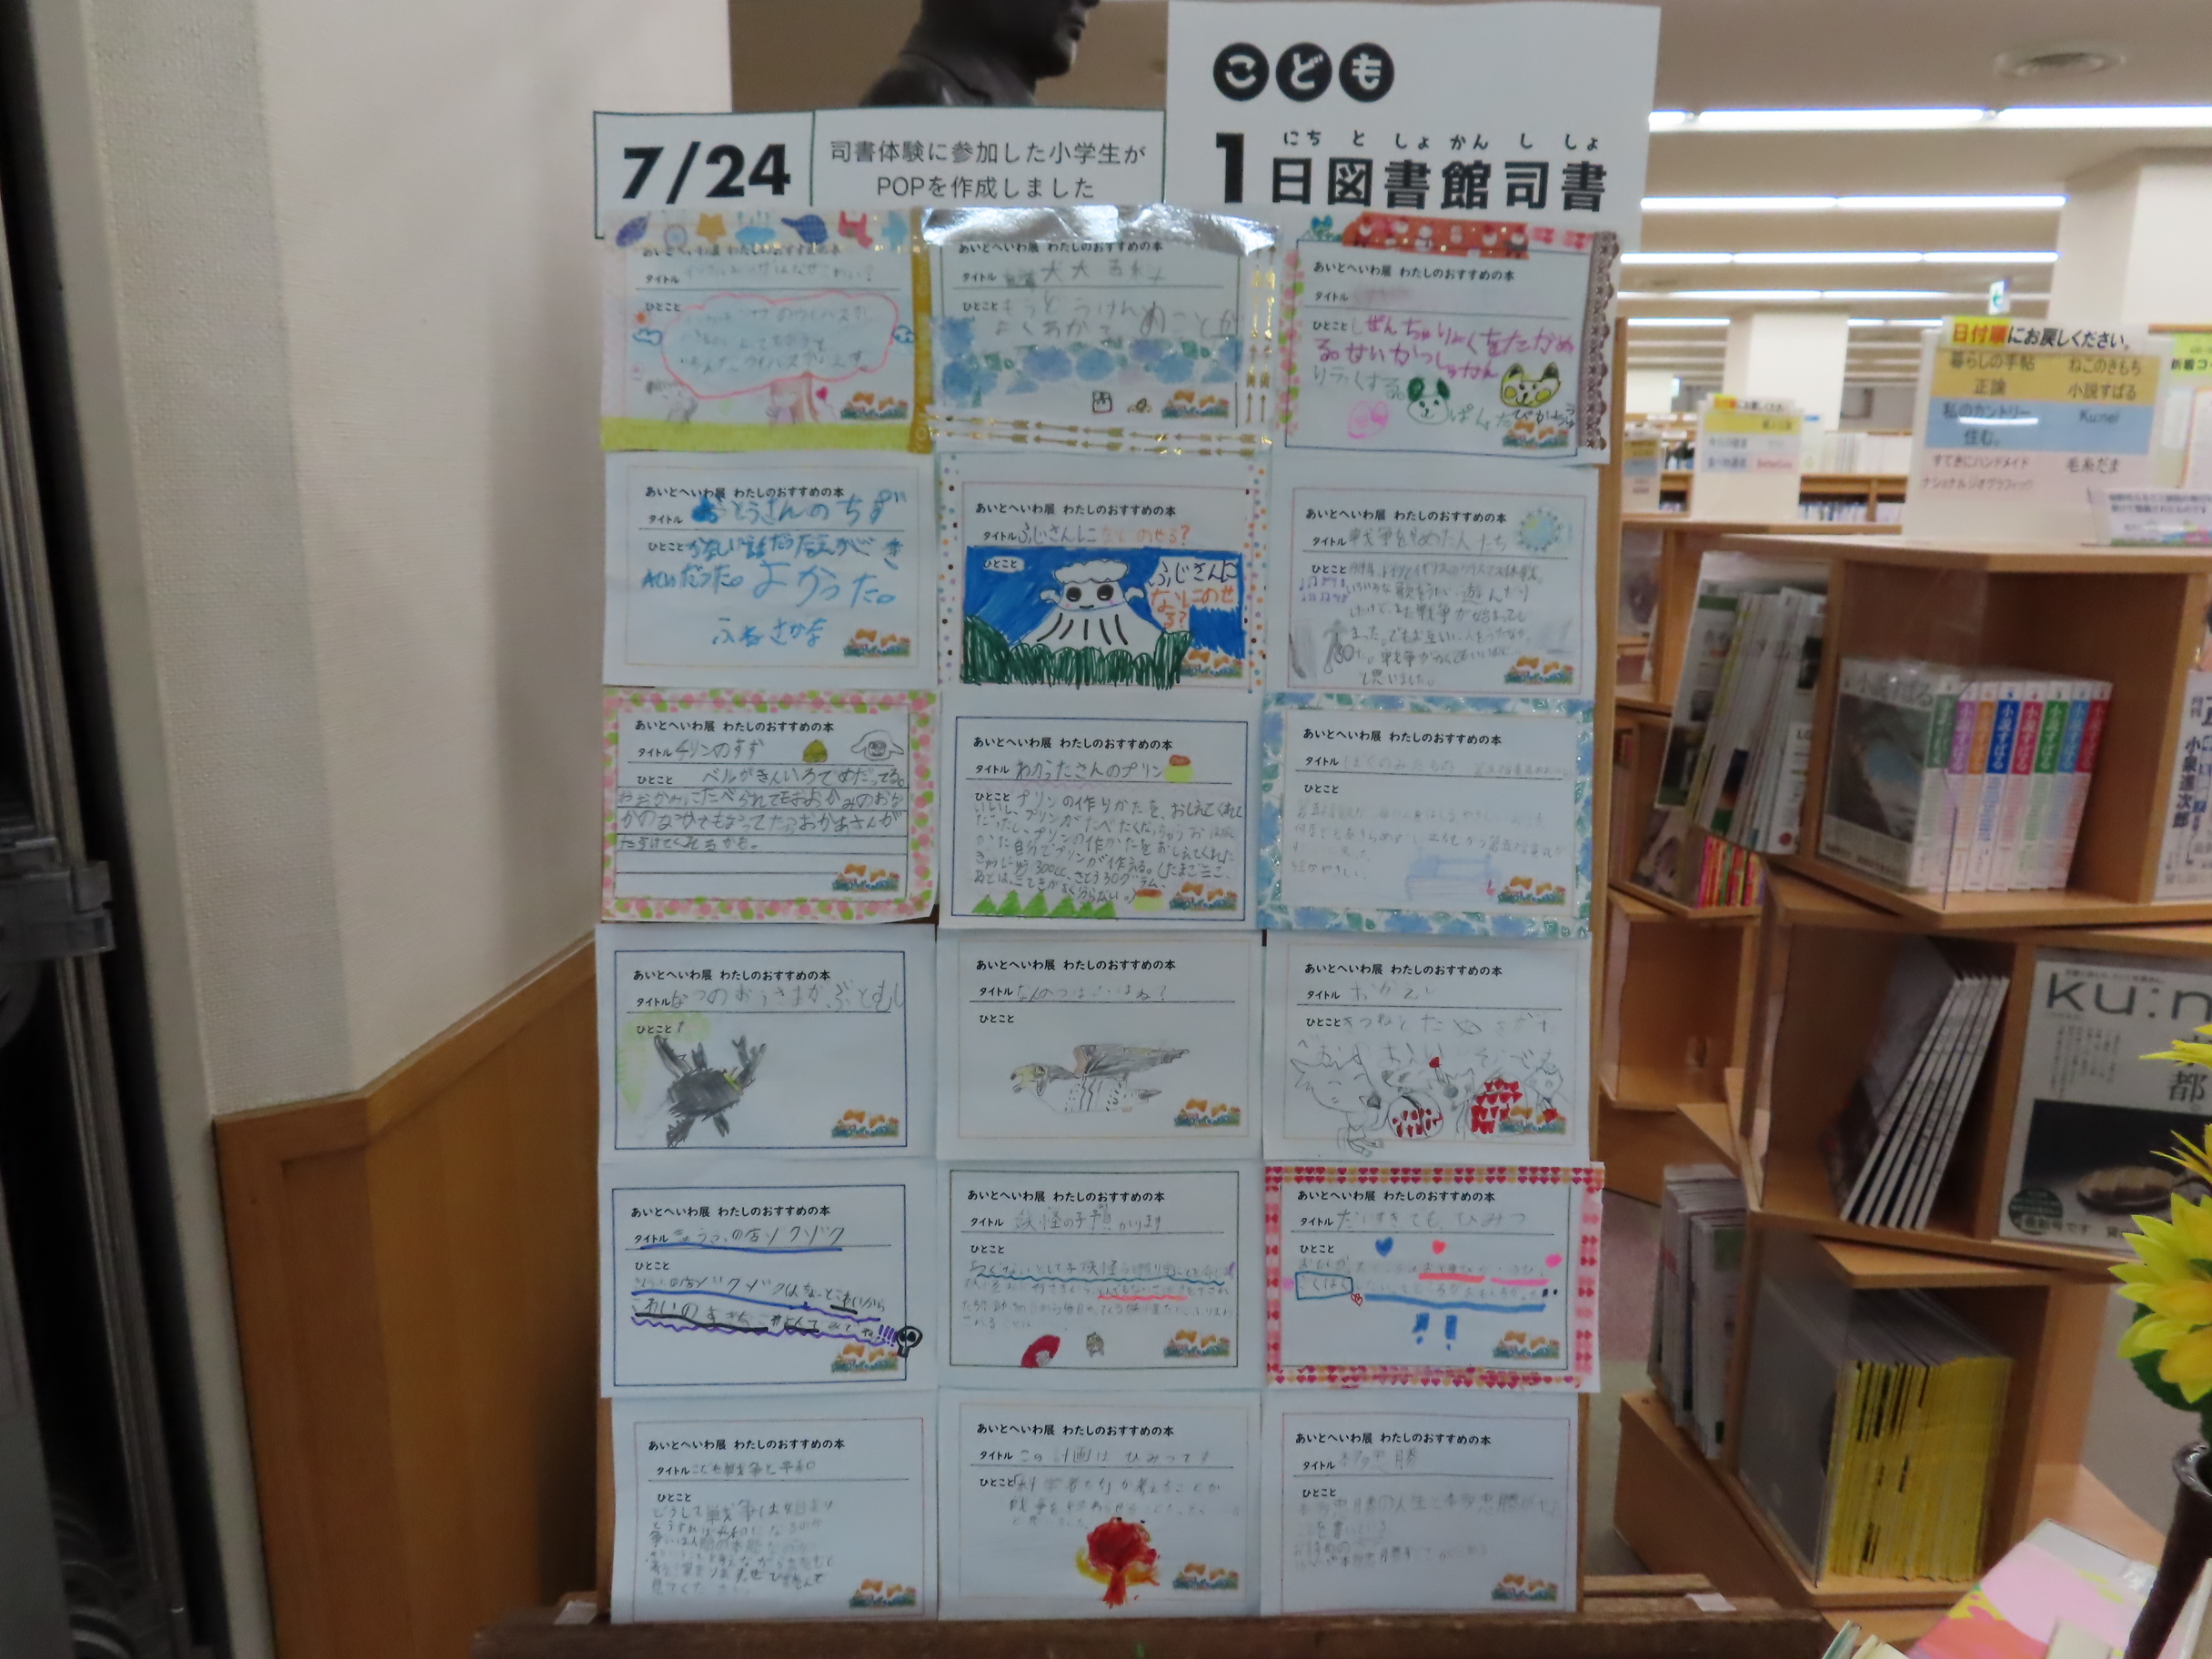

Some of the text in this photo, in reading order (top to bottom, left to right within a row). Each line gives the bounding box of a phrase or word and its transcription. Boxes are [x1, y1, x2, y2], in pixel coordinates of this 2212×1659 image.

[1219, 46, 1390, 97] こども
[1283, 130, 1599, 152] にち と しょ かん し しょ
[830, 139, 1147, 166] 司書体験に参加した小学生が
[622, 141, 790, 204] 7/24
[1216, 133, 1607, 212] 1日図書館司書
[877, 176, 1095, 200] POPを作成しました
[959, 241, 1162, 254] あいとへいわ展 わたしのおすすめの本
[962, 272, 996, 282] タイトル
[1313, 261, 1514, 282] あいとへいわ展 わたしのおすすめの本
[1315, 291, 1348, 302] タイトル
[963, 301, 998, 312] ひとこと
[1313, 320, 1348, 332] ひとこと
[646, 487, 845, 499] あいとへいわ展 わたしのおすすめの本
[976, 502, 1176, 517] あいとへいわ展 わたしのおすすめの本
[649, 515, 683, 525] タイトル
[1306, 508, 1507, 524] あいとへいわ展 わたしのおすすめの本
[983, 530, 1017, 541] タイトル
[649, 541, 683, 552] ひとこと
[1312, 536, 1346, 547] タイトル
[983, 558, 1018, 569] ひとこと
[1312, 564, 1346, 575] ひとこと
[636, 719, 834, 733] あいとへいわ展 わたしのおすすめの本
[1303, 728, 1502, 746] あいとへいわ展 わたしのおすすめの本
[973, 736, 1173, 750] あいとへいわ展 わたしのおすすめの本
[638, 747, 671, 758] タイトル
[1305, 756, 1339, 767] タイトル
[975, 764, 1010, 775] タイトル
[638, 775, 673, 785] ひとこと
[1303, 784, 1339, 794] ひとこと
[975, 791, 1010, 802] ひとこと
[976, 959, 1176, 971] あいとへいわ展 わたしのおすすめの本
[1304, 962, 1503, 977] あいとへいわ展 わたしのおすすめの本
[633, 969, 830, 981] あいとへいわ展 わたしのおすすめの本
[980, 987, 1013, 998] タイトル
[1307, 990, 1340, 1000] タイトル
[637, 997, 670, 1007] タイトル
[980, 1014, 1014, 1023] ひとこと
[1306, 1017, 1342, 1028] ひとこと
[637, 1024, 672, 1034] ひとこと
[968, 1190, 1165, 1203] あいとへいわ展 わたしのおすすめの本
[1297, 1190, 1495, 1203] あいとへいわ展 わたしのおすすめの本
[631, 1205, 830, 1218] あいとへいわ展 わたしのおすすめの本
[970, 1217, 1004, 1227] タイトル
[1300, 1216, 1333, 1227] タイトル
[635, 1233, 669, 1244] タイトル
[970, 1244, 1005, 1254] ひとこと
[1300, 1243, 1334, 1254] ひとこと
[635, 1261, 669, 1271] ひとこと
[977, 1423, 1175, 1436] あいとへいわ展 わたしのおすすめの本
[649, 1437, 846, 1451] あいとへいわ展 わたしのおすすめの本
[1296, 1433, 1492, 1446] あいとへいわ展 わたしのおすすめの本
[980, 1450, 1013, 1461] タイトル
[657, 1465, 690, 1476] タイトル
[1303, 1460, 1336, 1471] タイトル
[980, 1477, 1014, 1488] ひとこと
[657, 1493, 691, 1503] ひとこと
[1303, 1488, 1337, 1498] ひとこと
